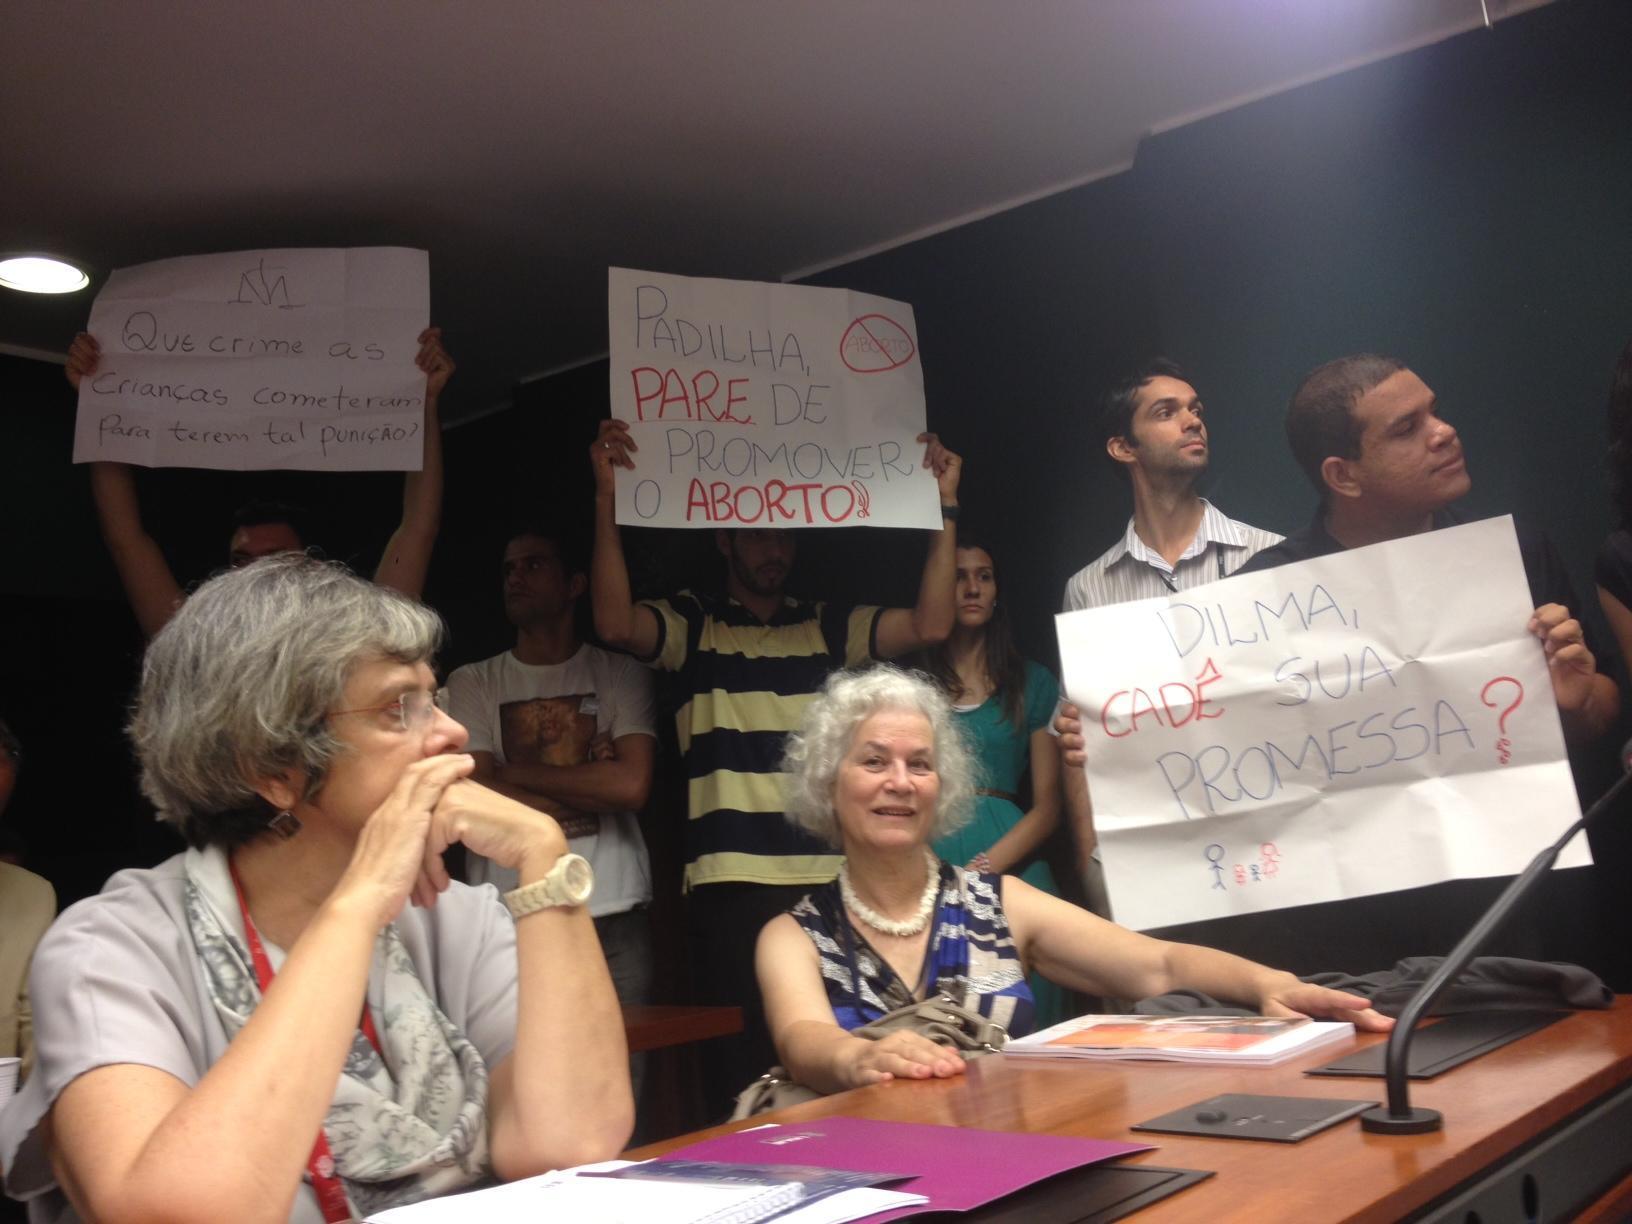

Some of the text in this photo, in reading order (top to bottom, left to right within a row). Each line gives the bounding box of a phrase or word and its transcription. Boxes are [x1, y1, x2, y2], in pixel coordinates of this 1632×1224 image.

[328, 342, 385, 360] as
[631, 366, 831, 425] PARE DE
[167, 420, 249, 443] terem
[263, 420, 305, 445] tal
[666, 428, 914, 481] PROMOVER
[634, 479, 661, 519] O
[1156, 584, 1360, 657] DILMA,
[1101, 645, 1397, 738] CADÊ SUA
